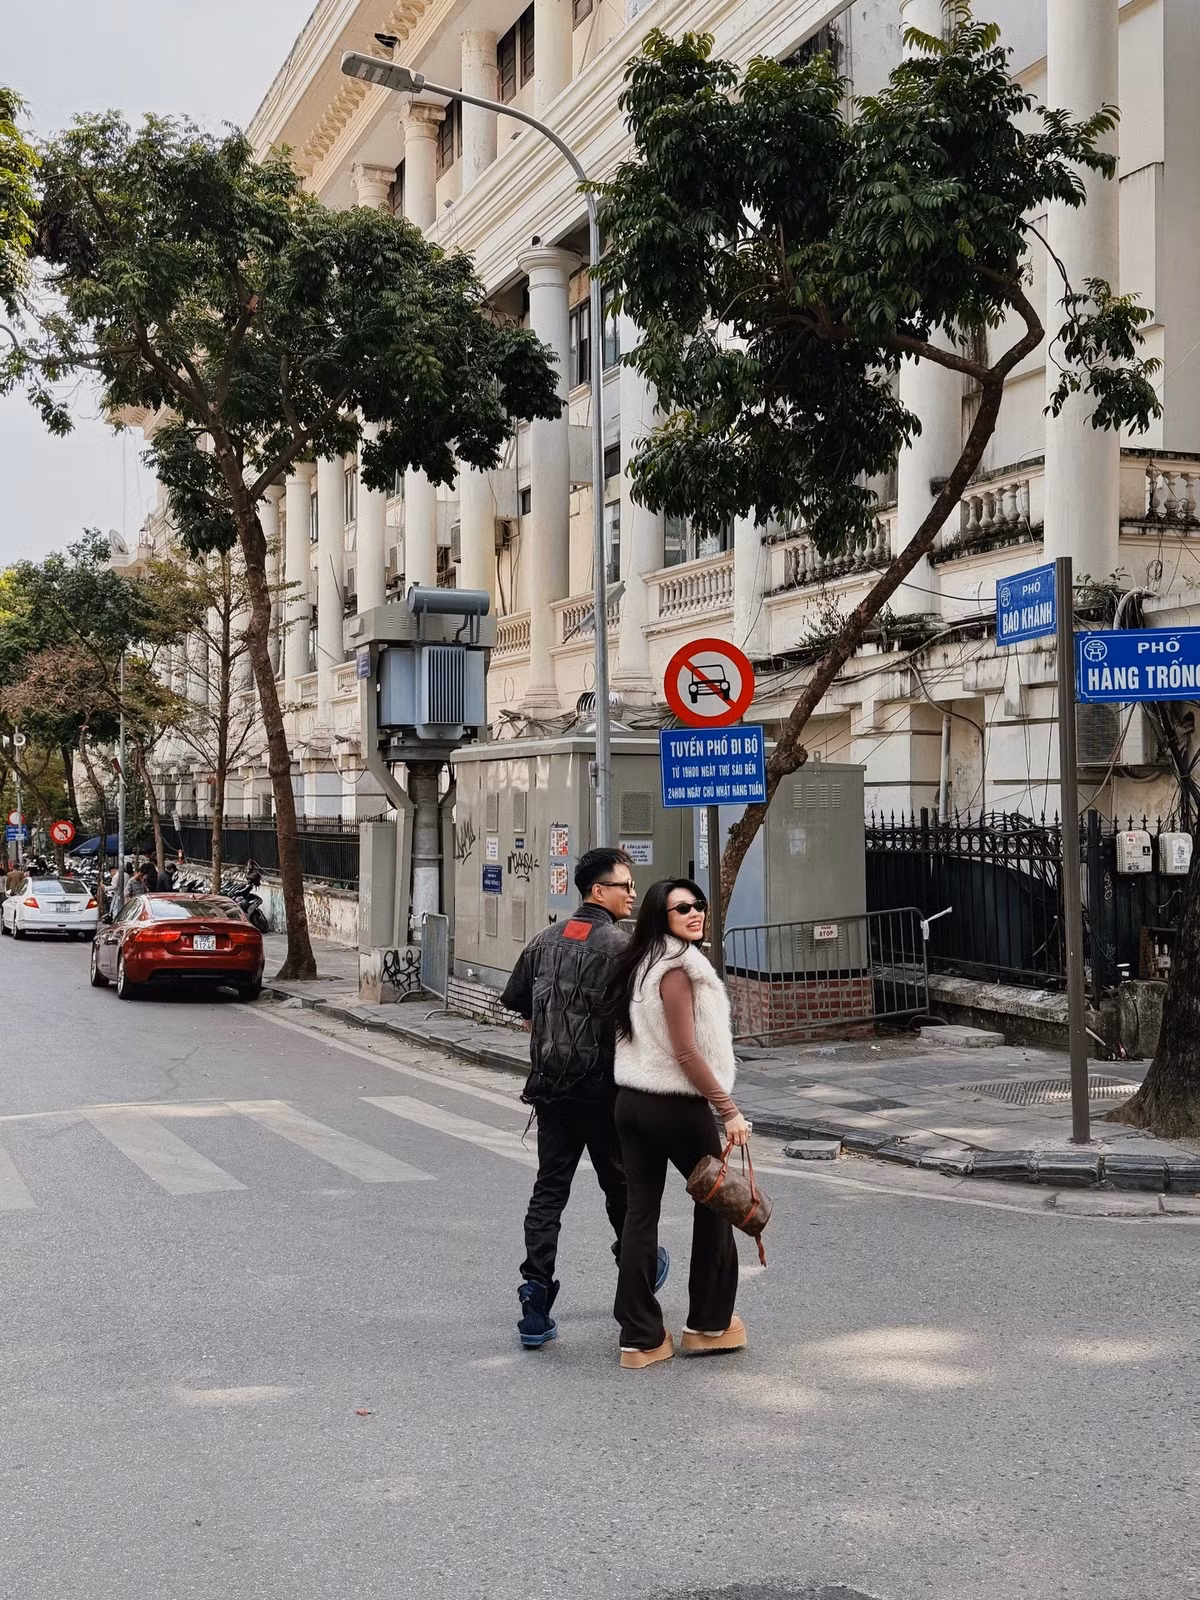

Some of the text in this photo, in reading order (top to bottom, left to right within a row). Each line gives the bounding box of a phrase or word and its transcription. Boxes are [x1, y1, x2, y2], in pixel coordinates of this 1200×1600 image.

[1022, 576, 1040, 596] PHỐ
[1021, 600, 1053, 631] KHÁNH
[1137, 635, 1181, 653] PHỐ
[1088, 662, 1139, 690] HÀNG
[670, 734, 758, 758] TUYẾN PHỐ ĐI BỘ
[672, 760, 756, 779] TỪ 19H00 NGÀY THỨ SÁU ĐẾN
[687, 784, 702, 798] NGÀY
[703, 781, 715, 797] CHỦ
[716, 783, 731, 799] NHẬT
[732, 782, 748, 796] HÀNG
